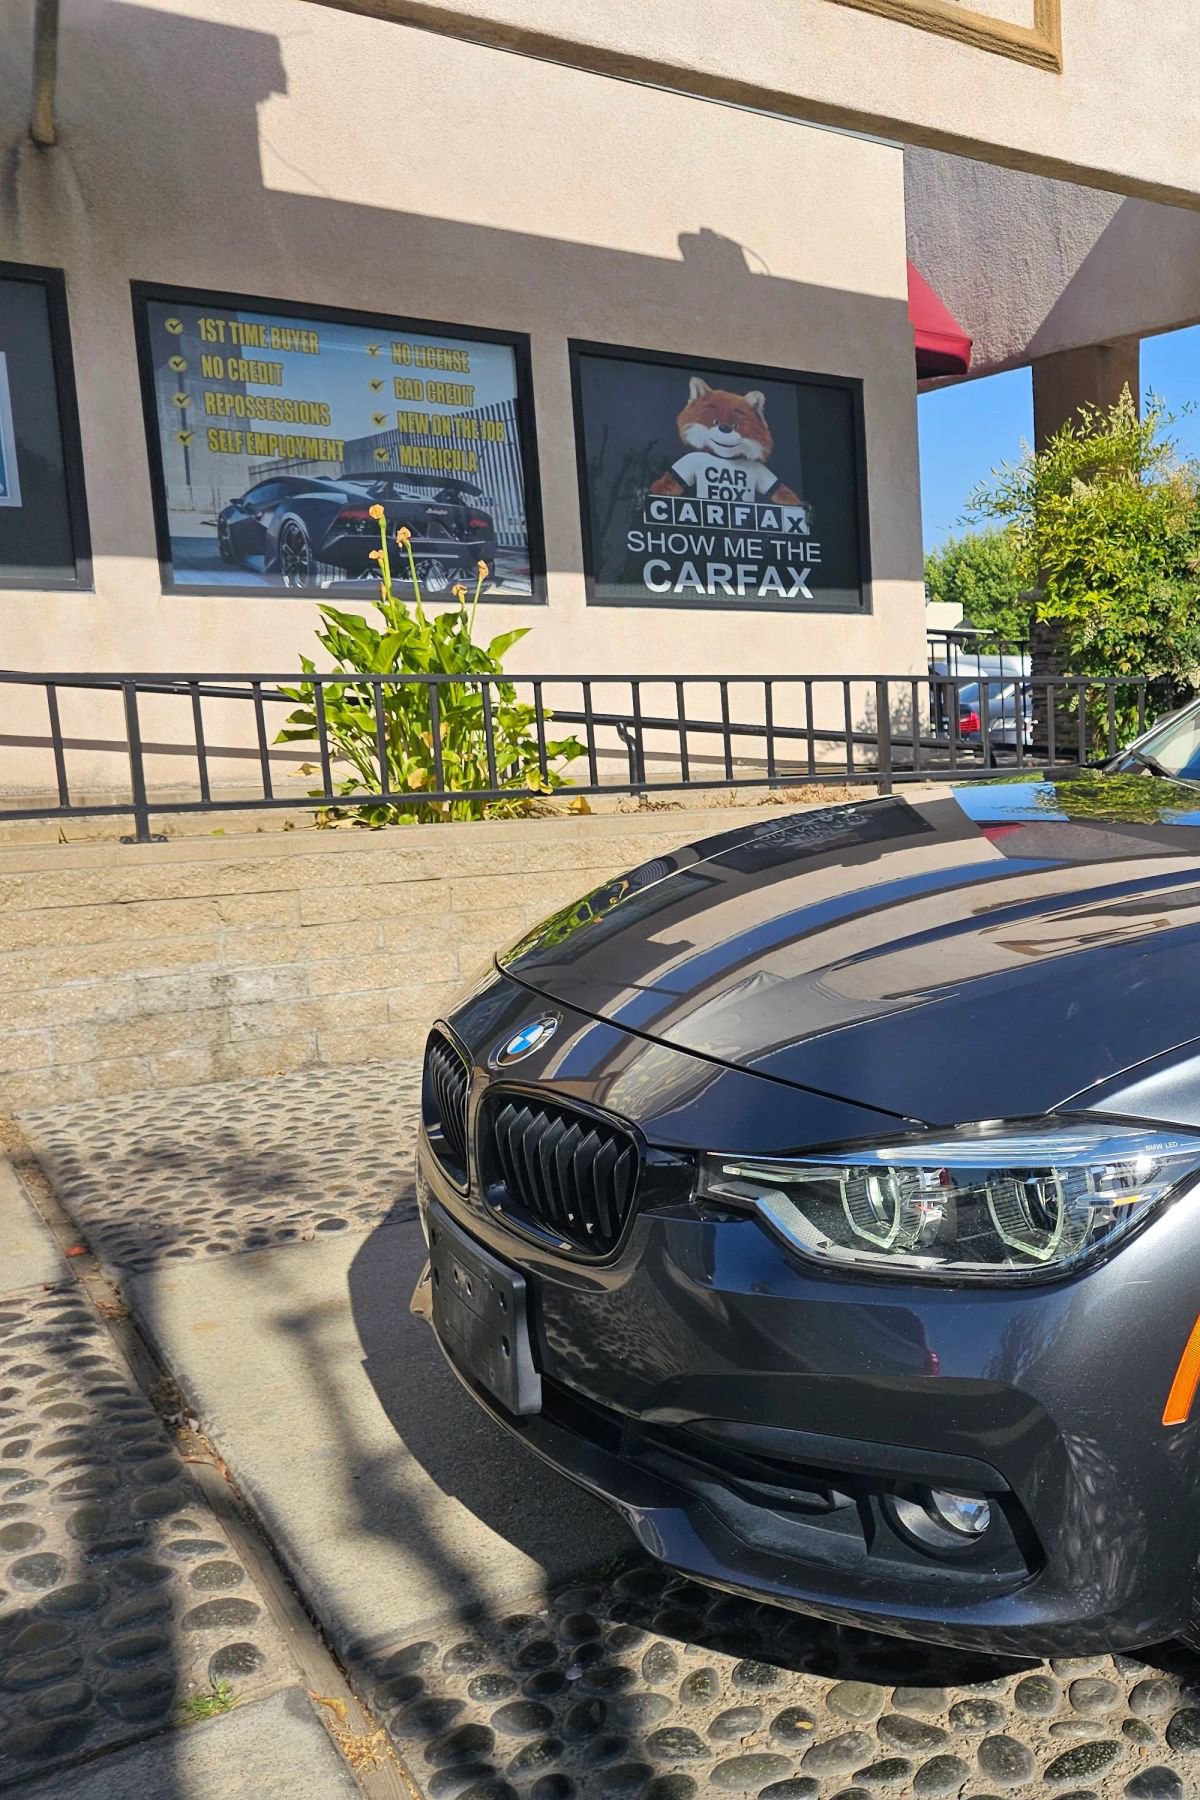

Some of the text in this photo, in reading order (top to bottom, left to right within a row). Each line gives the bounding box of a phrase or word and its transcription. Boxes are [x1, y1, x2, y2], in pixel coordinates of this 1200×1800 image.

[197, 317, 320, 355] 1ST TIME BUYER
[200, 354, 283, 386] NO CREDIT
[393, 341, 470, 374] NO LICENSE
[203, 390, 331, 427] REPOSSESSIONS
[394, 377, 475, 407] BAD CREDIT
[398, 410, 505, 443] NEW ON THE JOB
[207, 426, 345, 463] SELF EMPLOYMENT
[399, 443, 478, 475] MATRICULA
[704, 466, 748, 488] CAR
[708, 485, 746, 502] FOX
[649, 500, 807, 535] CARFAX
[626, 530, 822, 563] SHOW ME THE
[643, 558, 814, 600] CARFAX
[1165, 1141, 1178, 1149] LED
